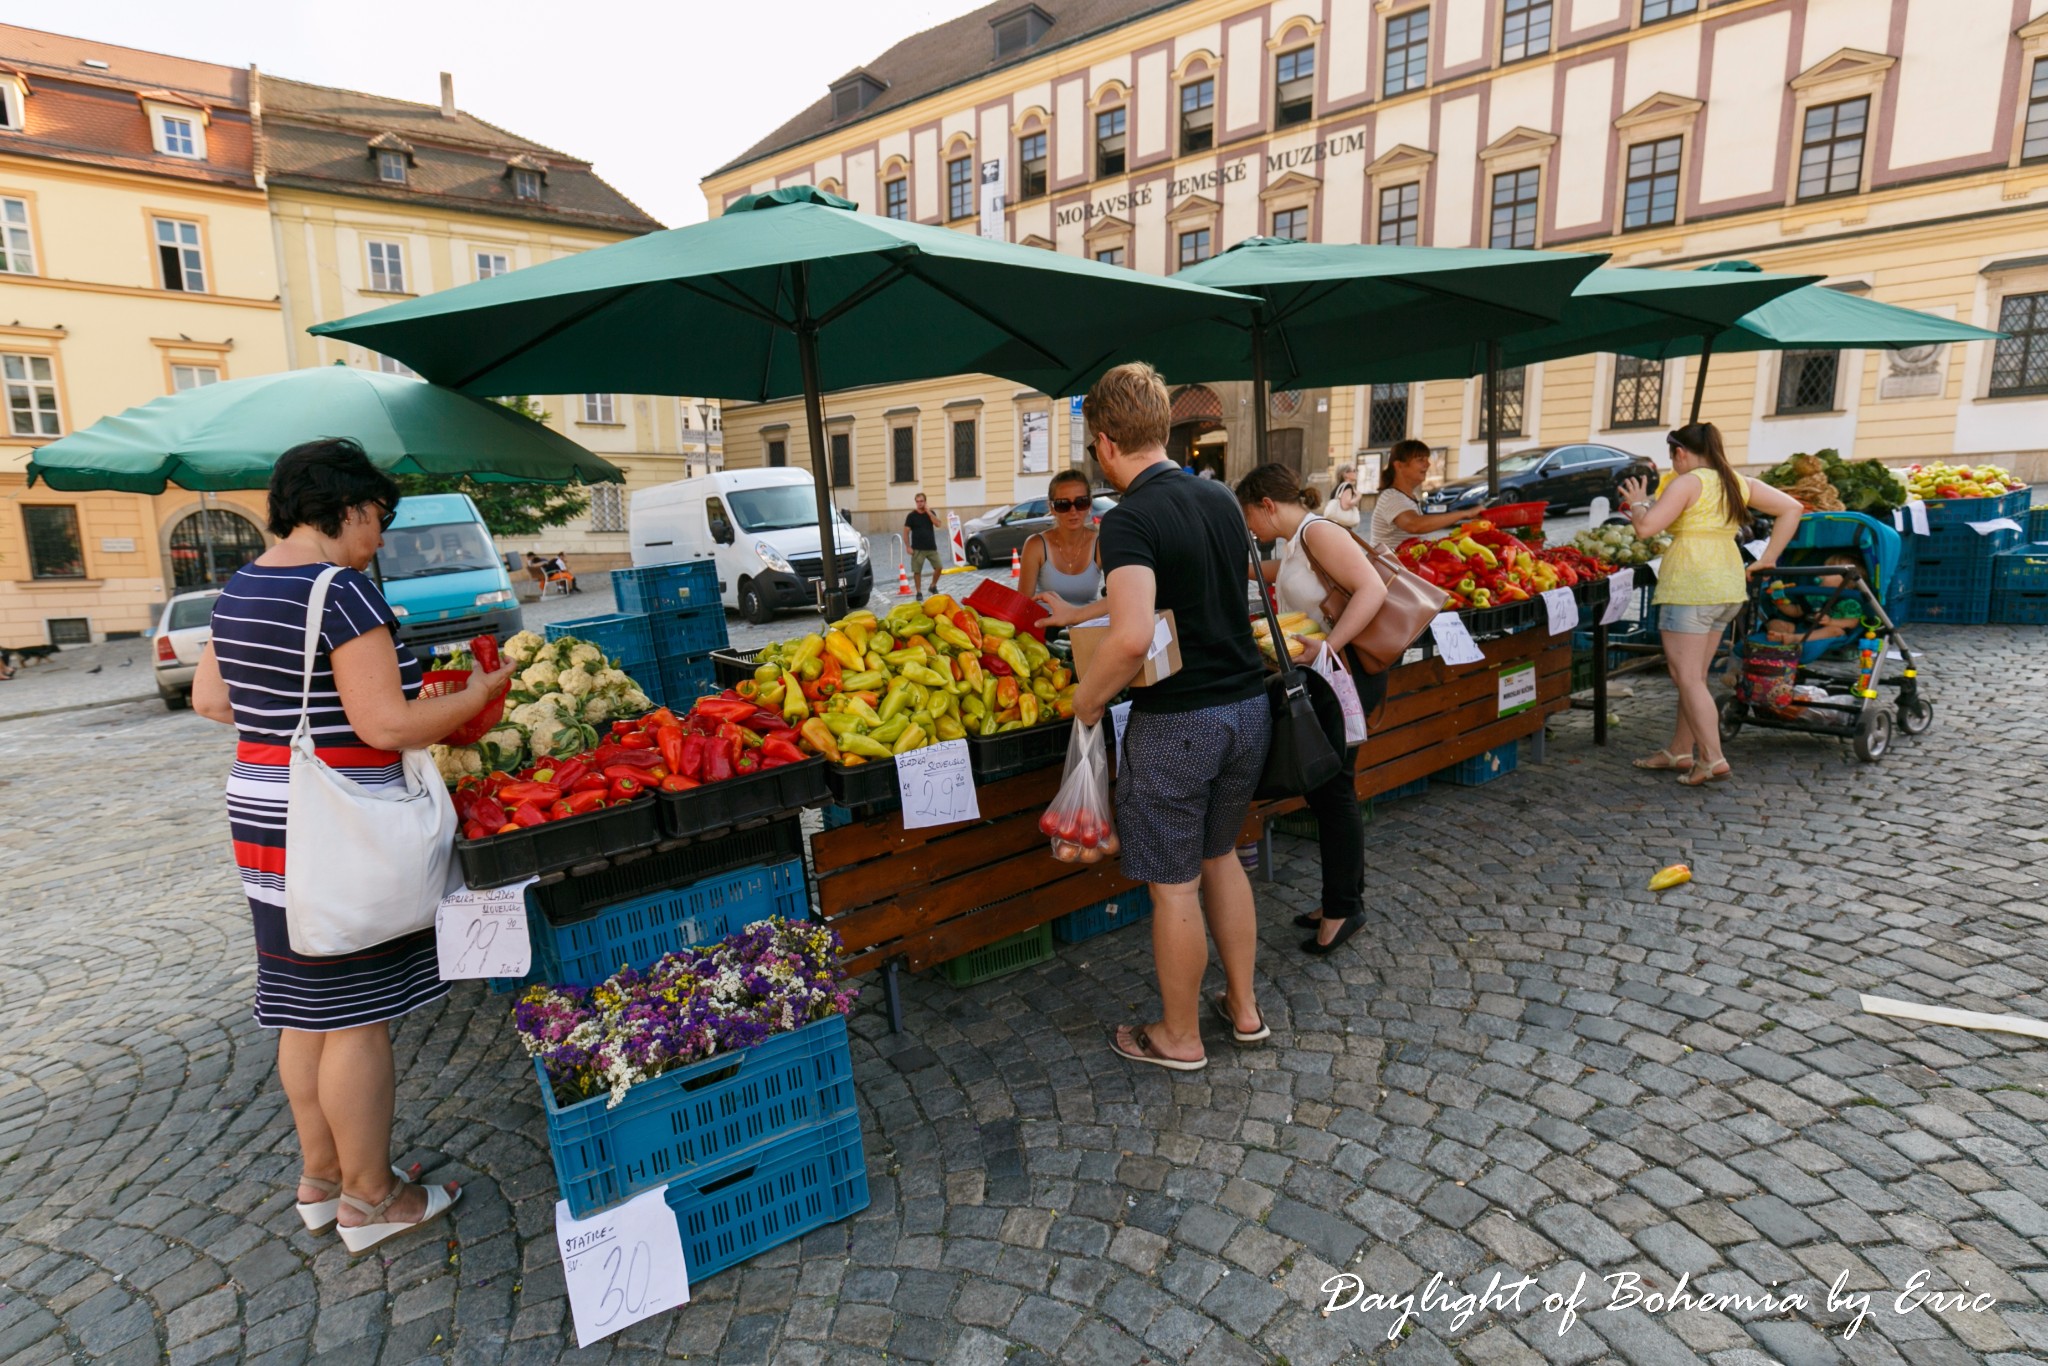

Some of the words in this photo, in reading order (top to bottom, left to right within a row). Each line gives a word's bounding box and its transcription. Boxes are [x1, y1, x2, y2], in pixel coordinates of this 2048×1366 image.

[1056, 184, 1152, 227] MORAVSKÉ
[1166, 161, 1247, 199] ZEMSKÉ
[1265, 131, 1365, 173] MUZEUM
